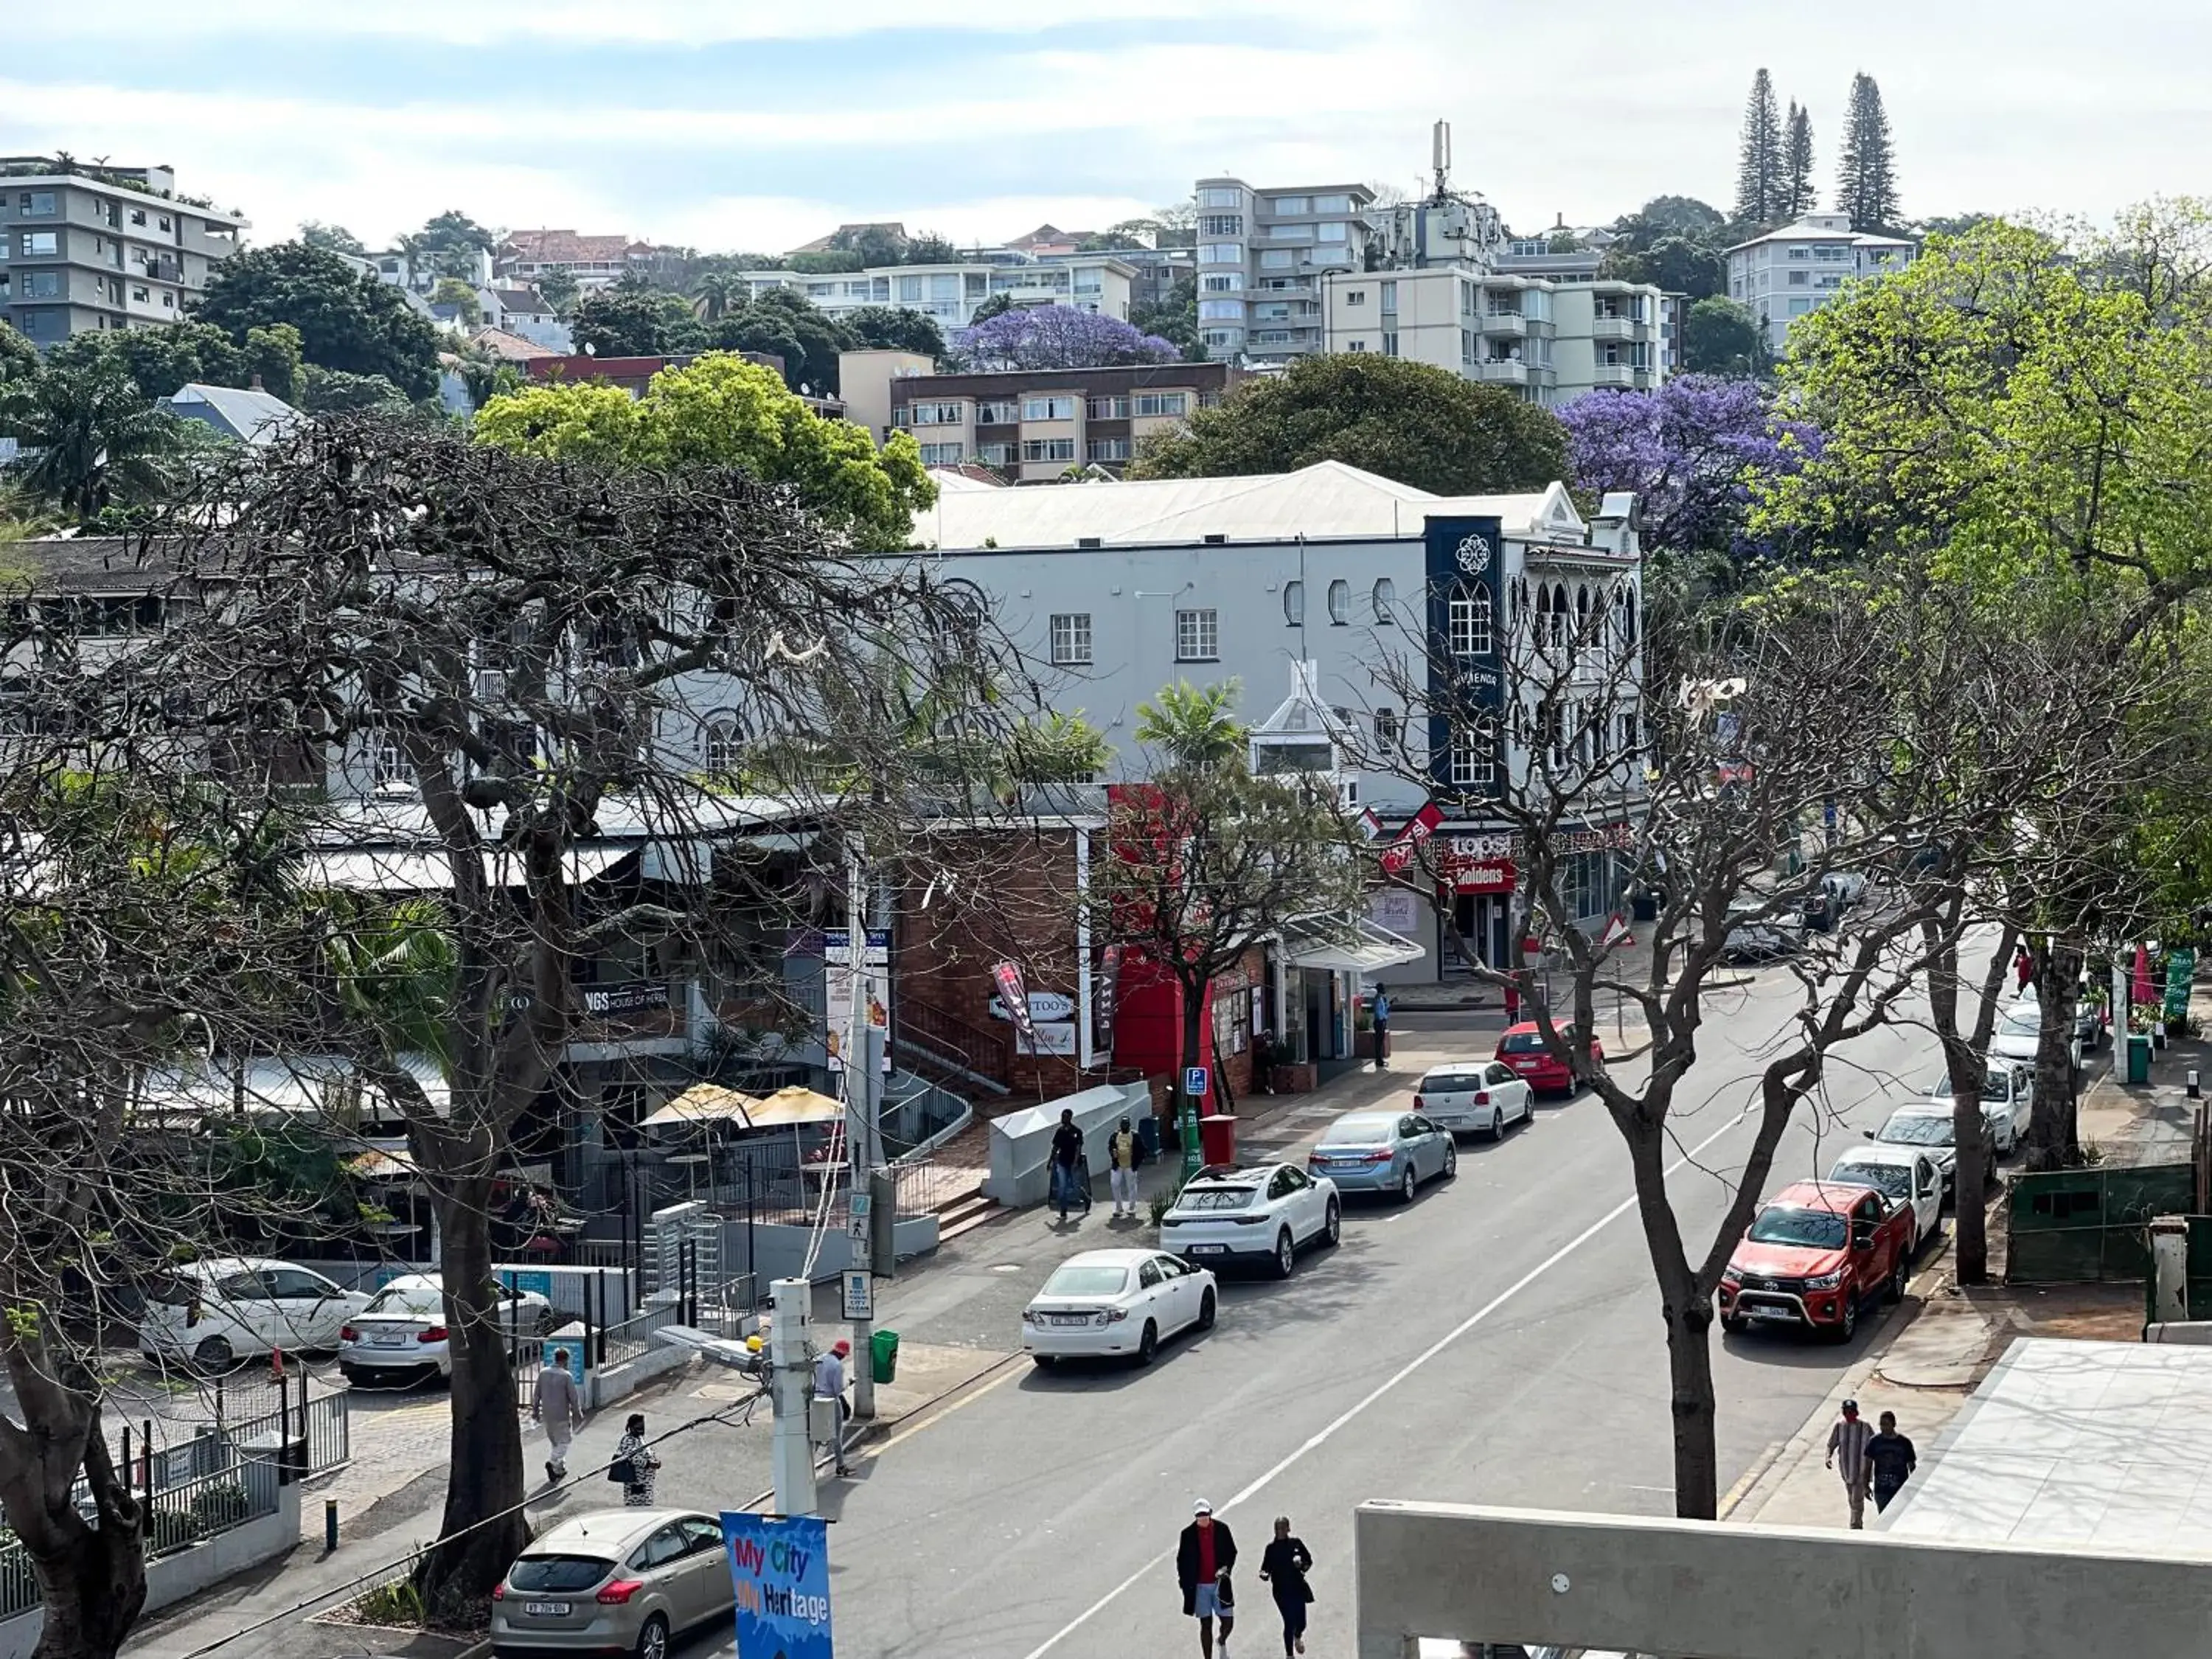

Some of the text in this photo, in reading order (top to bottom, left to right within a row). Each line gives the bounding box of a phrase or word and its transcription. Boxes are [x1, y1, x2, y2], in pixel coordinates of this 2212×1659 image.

[1192, 1070, 1201, 1080] P
[734, 1538, 810, 1582] My City
[763, 1583, 827, 1625] Heritage
